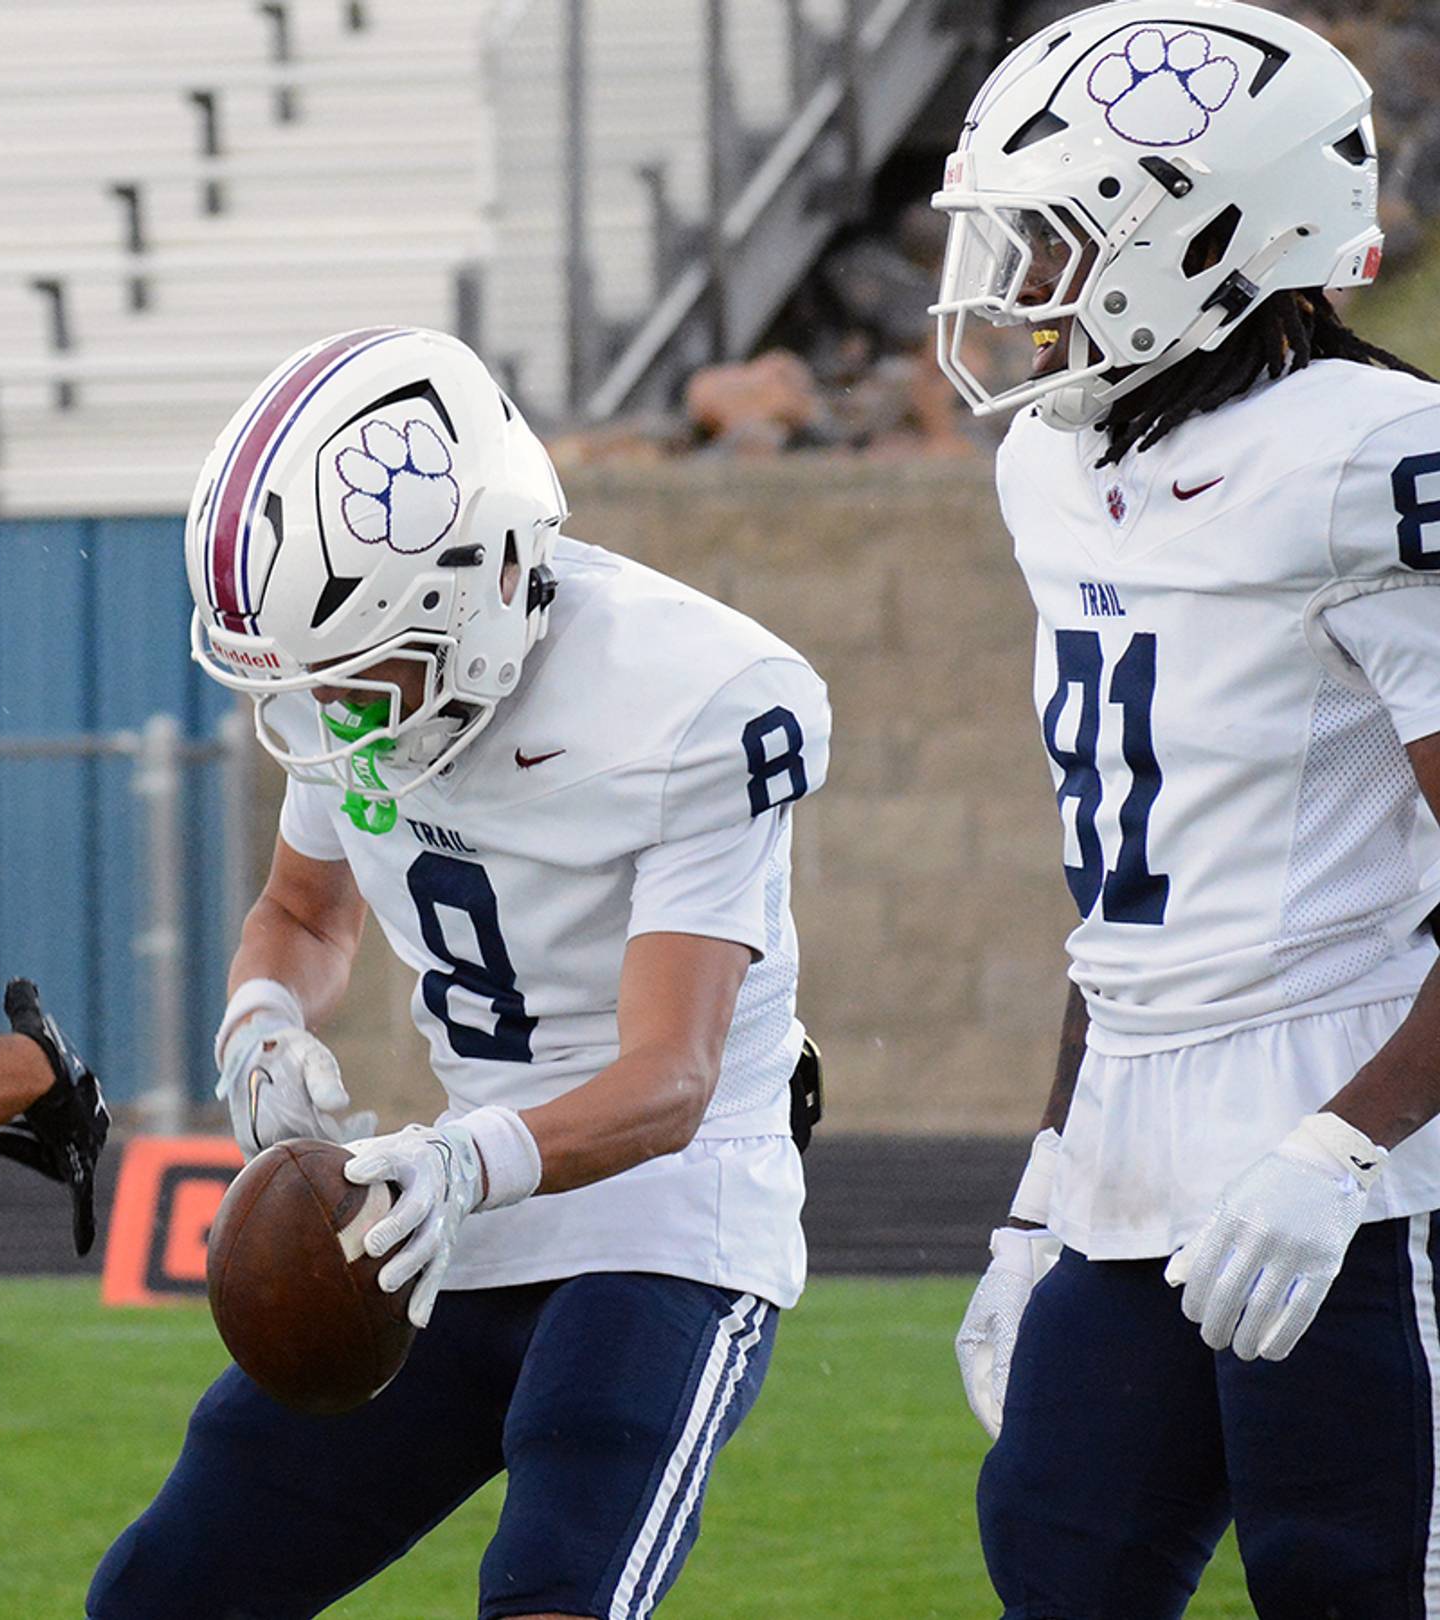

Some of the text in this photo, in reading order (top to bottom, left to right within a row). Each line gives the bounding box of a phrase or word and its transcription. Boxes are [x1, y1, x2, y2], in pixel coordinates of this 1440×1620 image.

[1079, 582, 1126, 616] TRAIL
[741, 705, 808, 818] 8
[405, 817, 477, 852] TRAIL
[406, 850, 539, 1064] 8
